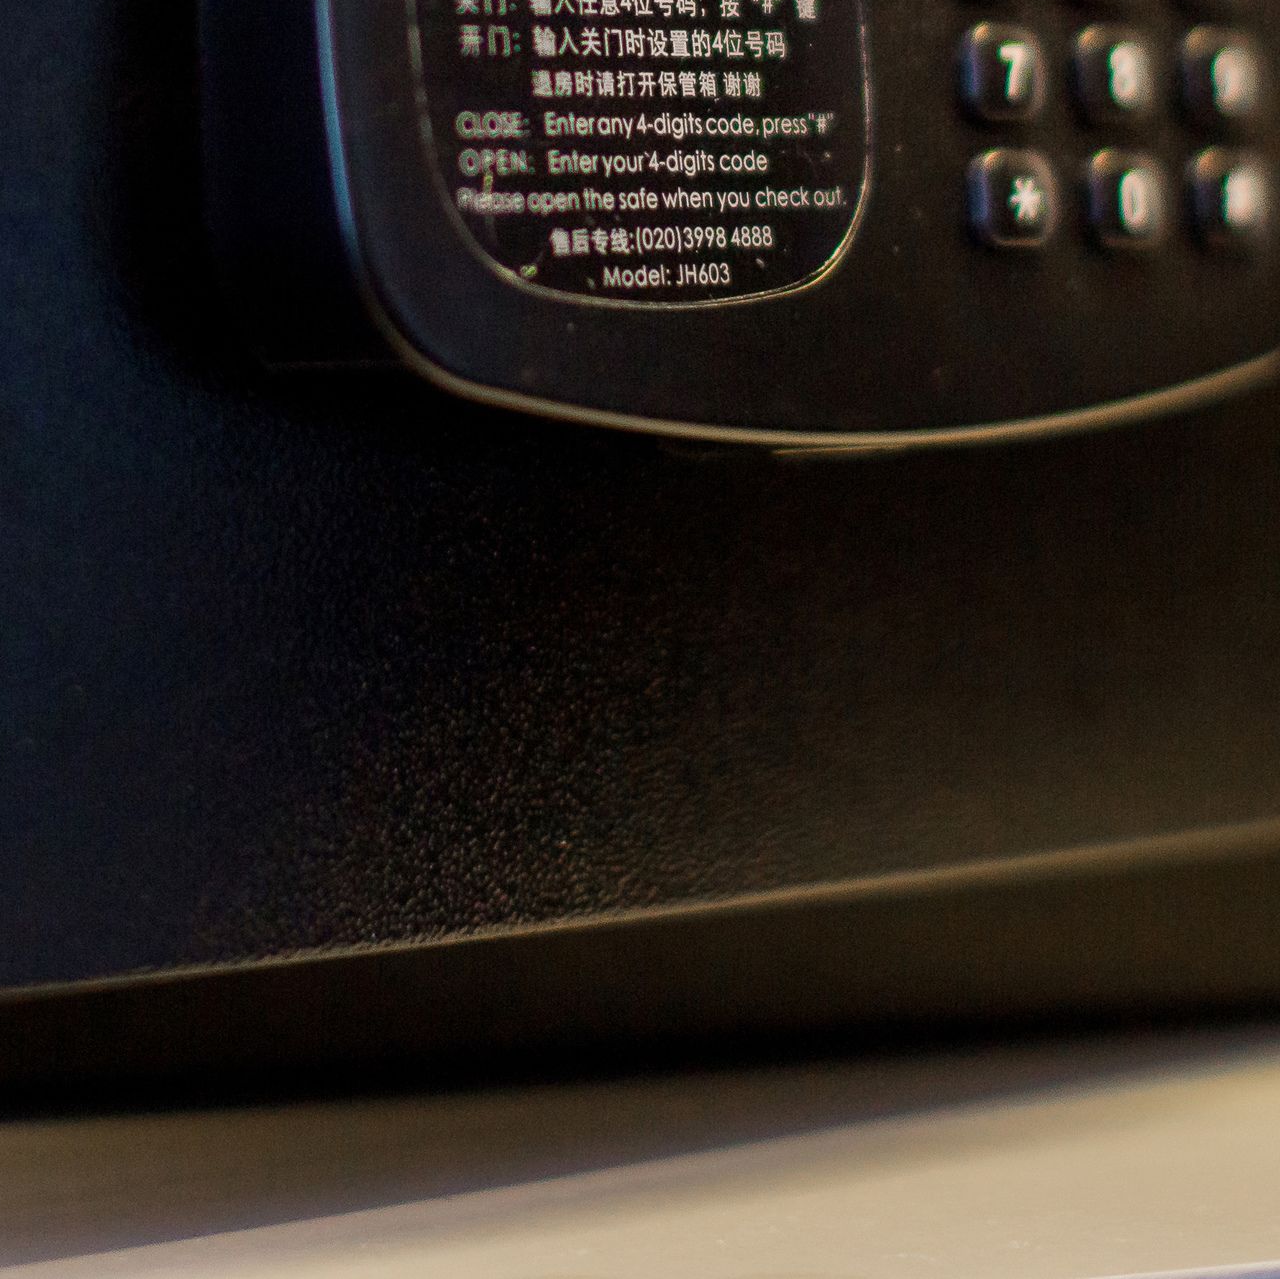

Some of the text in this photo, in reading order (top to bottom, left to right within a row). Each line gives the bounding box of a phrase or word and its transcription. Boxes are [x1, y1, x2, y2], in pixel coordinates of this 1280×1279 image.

[998, 40, 1032, 102] 7
[456, 111, 530, 138] CLOSE:
[544, 111, 594, 136] Enter
[597, 117, 633, 140] any
[636, 112, 702, 140] 4-digits
[458, 148, 768, 178] OPEN: Enter your 4-digits code
[456, 186, 525, 214] Please
[526, 191, 580, 217] open
[583, 187, 615, 210] the
[618, 186, 659, 209] safe
[662, 186, 713, 209] when
[716, 190, 751, 213] you
[754, 186, 810, 207] check
[1120, 168, 1160, 234] 0
[730, 225, 773, 247] 4888
[602, 263, 730, 288] Model: JH603
